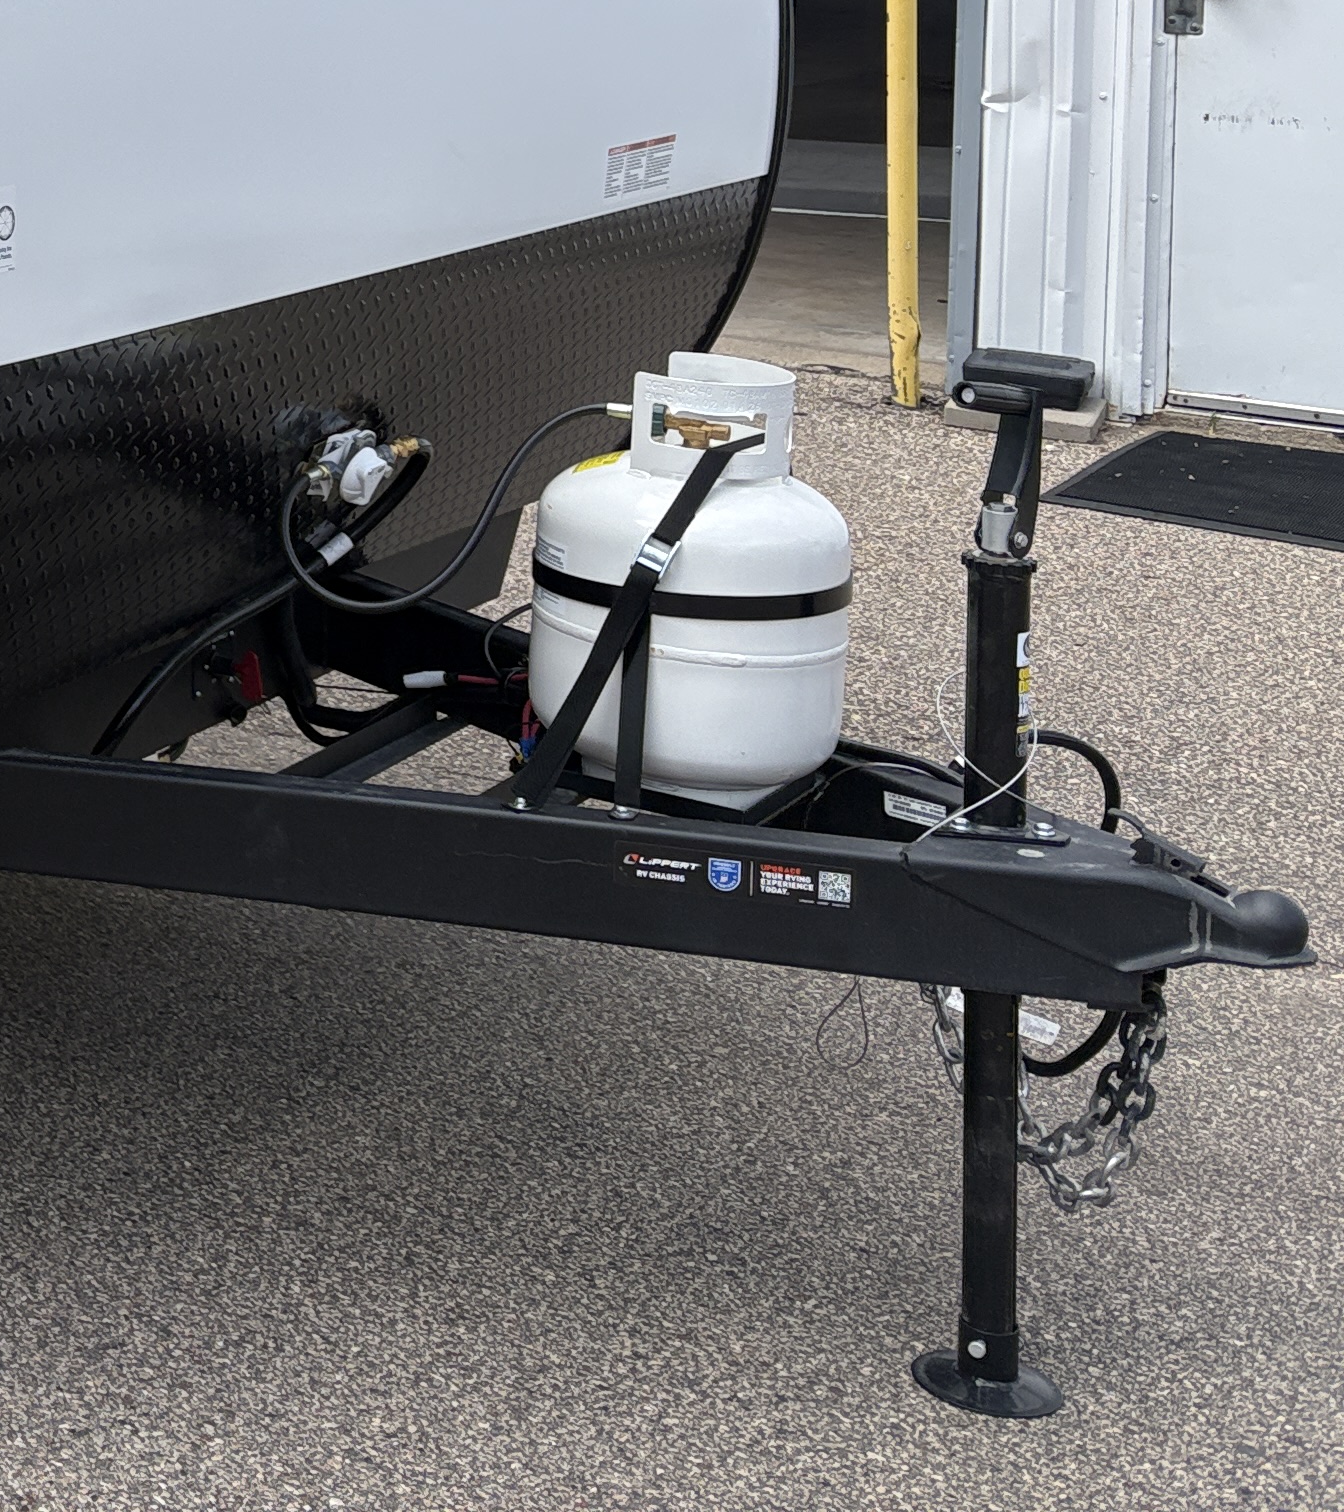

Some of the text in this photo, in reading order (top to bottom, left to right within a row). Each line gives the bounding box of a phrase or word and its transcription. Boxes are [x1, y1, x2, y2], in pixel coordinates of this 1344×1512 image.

[639, 857, 702, 872] LIPPERT
[636, 869, 687, 883] RV CHASSIS
[760, 871, 812, 884] YOUR RVING
[760, 878, 814, 892] EXPERIENCE
[760, 885, 790, 896] TODAY.
